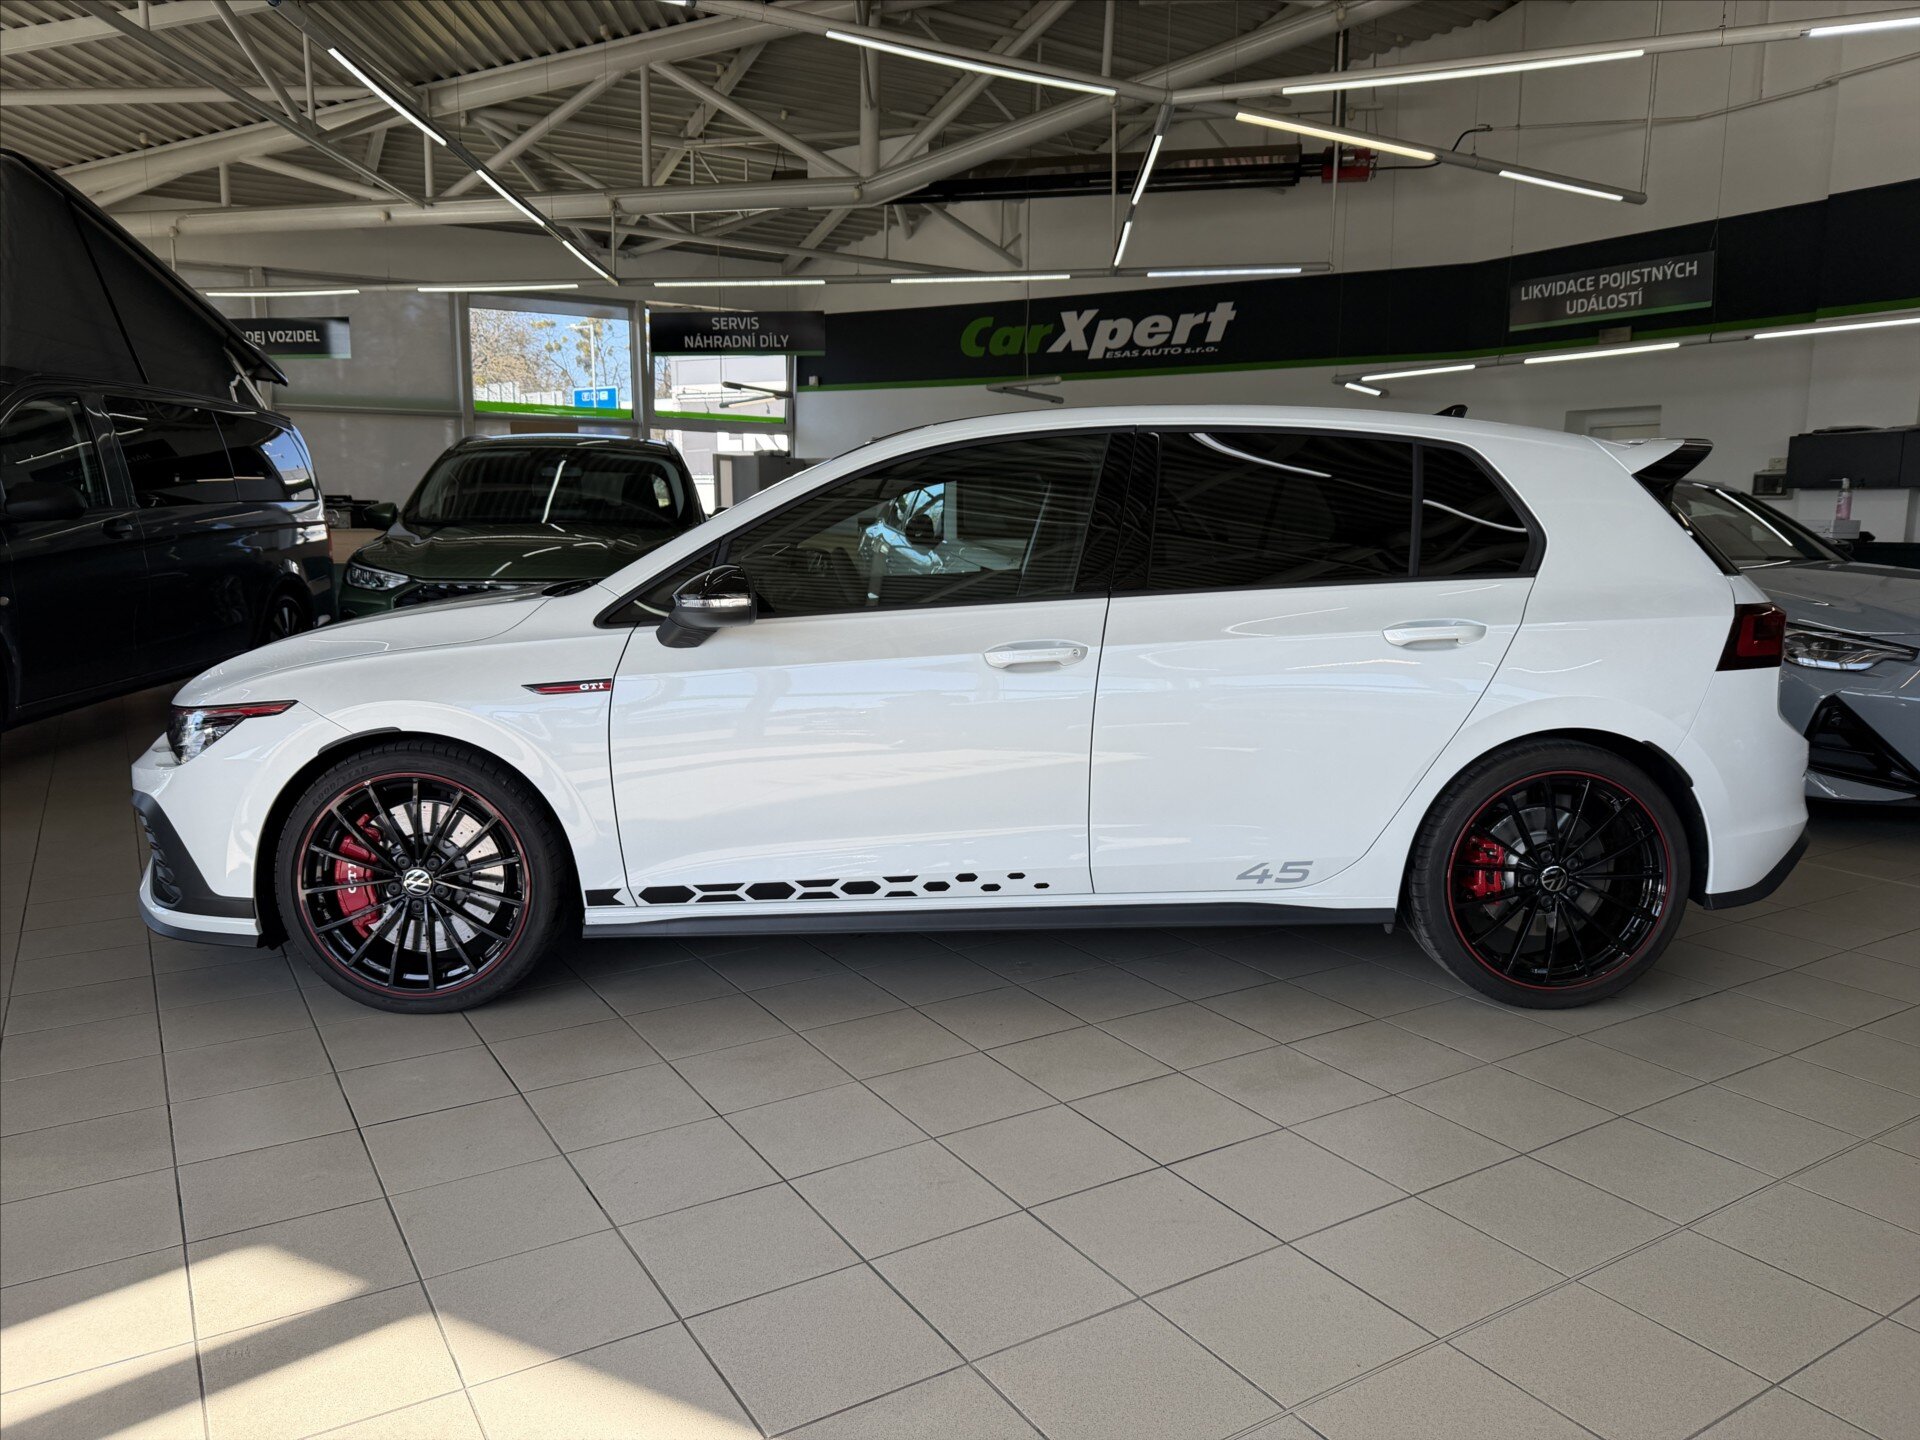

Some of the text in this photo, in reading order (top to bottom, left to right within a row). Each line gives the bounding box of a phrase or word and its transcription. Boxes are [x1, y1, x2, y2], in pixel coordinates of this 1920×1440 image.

[1521, 260, 1698, 301] LIKVIDACE POJISTNÝCH
[1566, 288, 1644, 315] UDÁLOSTÍ
[711, 317, 760, 330] SERVIS
[960, 301, 1237, 360] CarXpert
[242, 330, 320, 345] DEJ VOZIDEL
[684, 332, 789, 348] NÁHRADNÍ DÍLY
[1105, 345, 1219, 359] ESAS AUTO s.r.o.
[580, 682, 604, 691] GTI
[1235, 860, 1314, 884] 45
